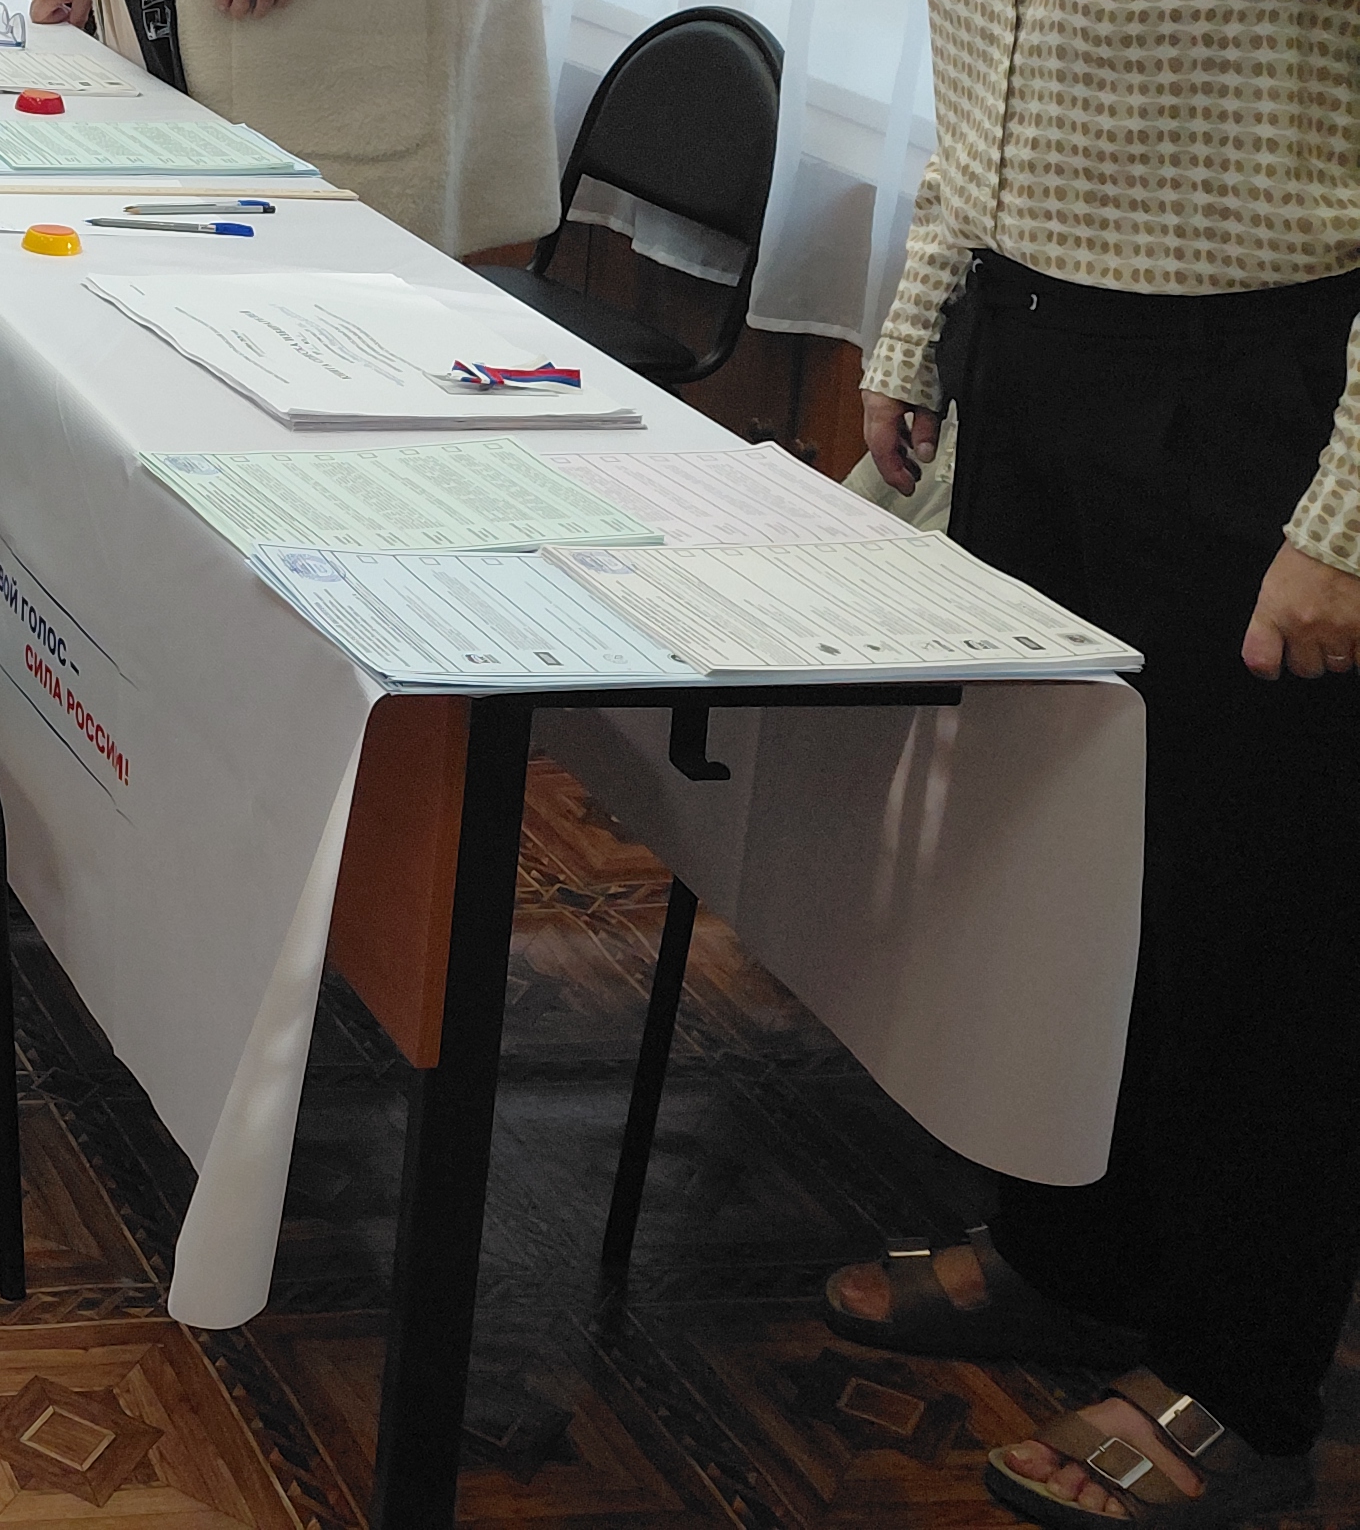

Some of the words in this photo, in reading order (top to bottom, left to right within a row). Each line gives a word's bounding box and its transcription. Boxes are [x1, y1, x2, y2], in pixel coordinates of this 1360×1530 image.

[21, 596, 67, 667] ГОЛОС
[25, 644, 63, 707] СИЛА
[66, 687, 129, 787] РОССИИ!
